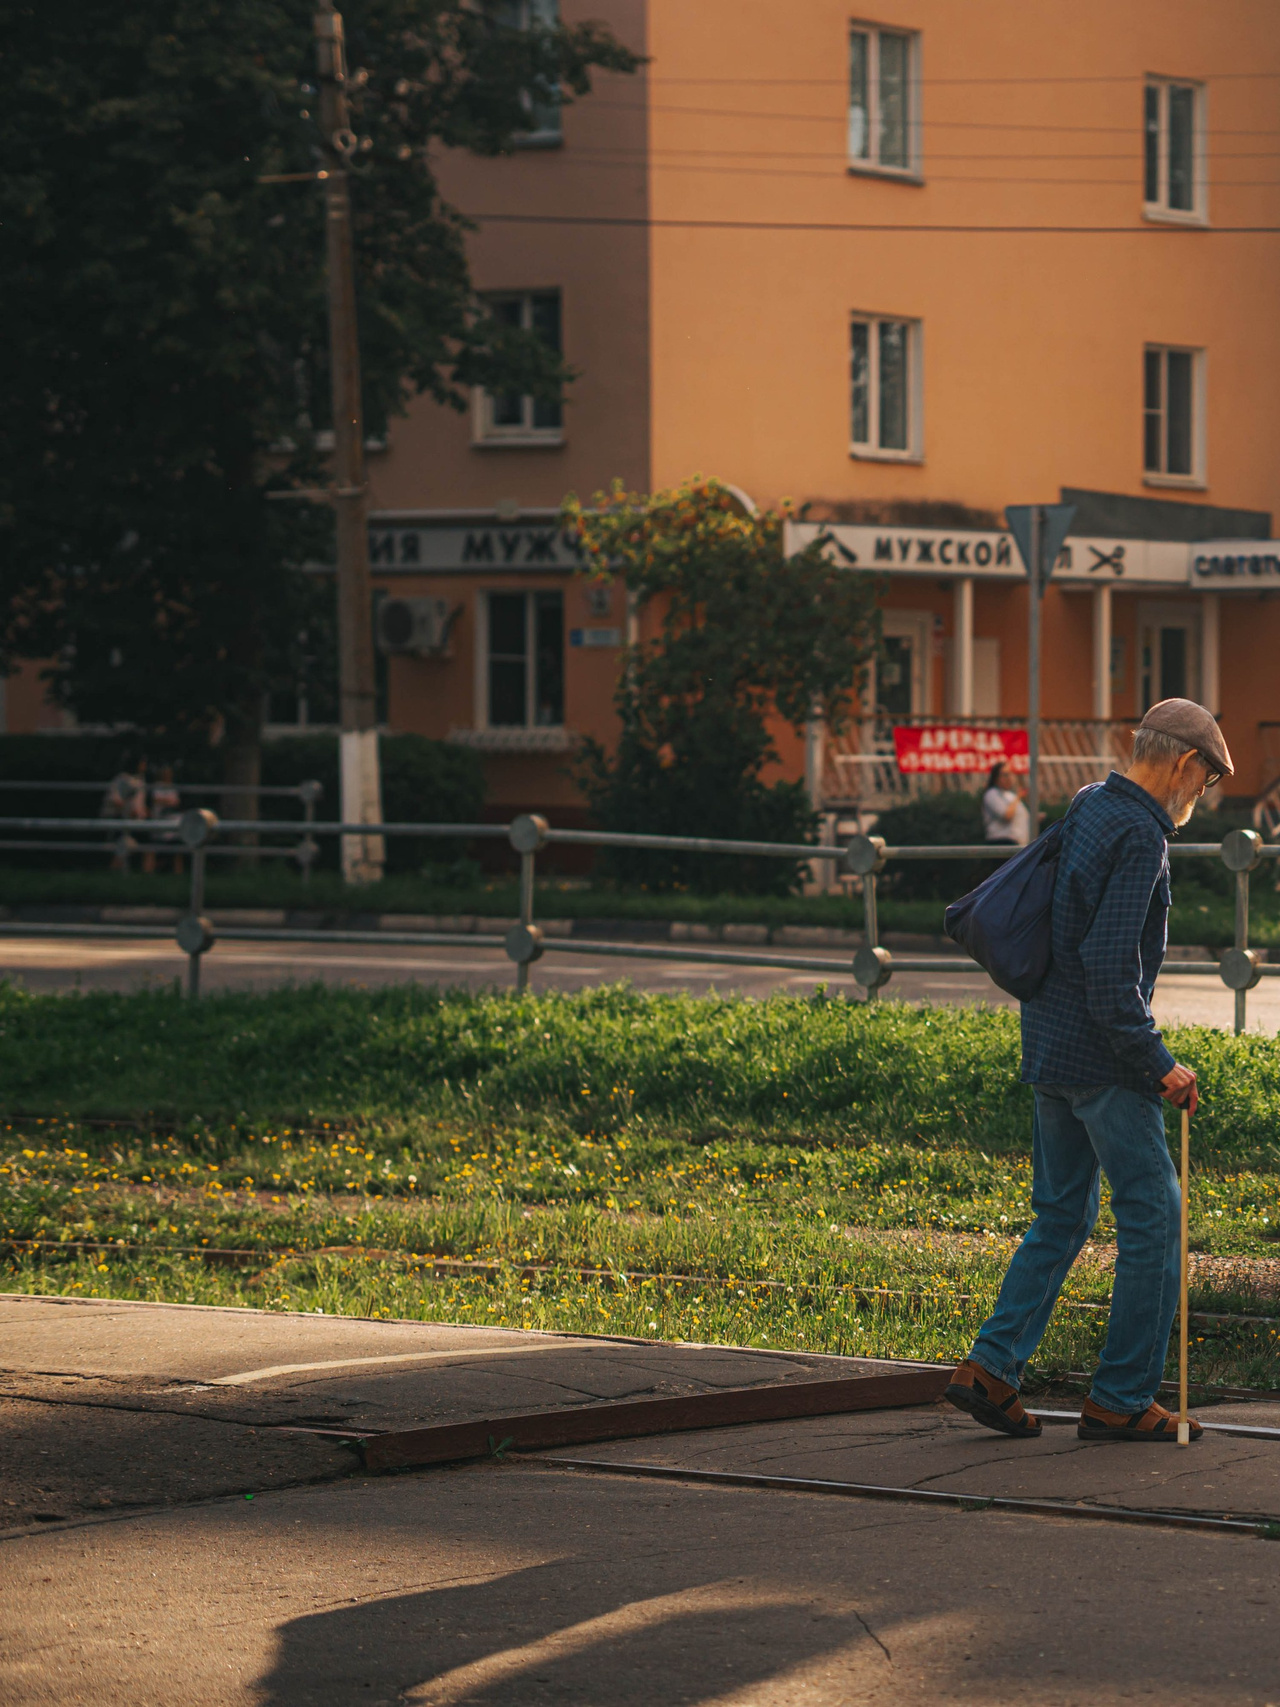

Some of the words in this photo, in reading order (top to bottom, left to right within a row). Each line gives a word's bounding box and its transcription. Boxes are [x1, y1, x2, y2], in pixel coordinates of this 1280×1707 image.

[368, 531, 420, 563] ИЯ
[462, 531, 585, 562] МУЖЧ
[873, 536, 1012, 567] МУЖСКОЙ
